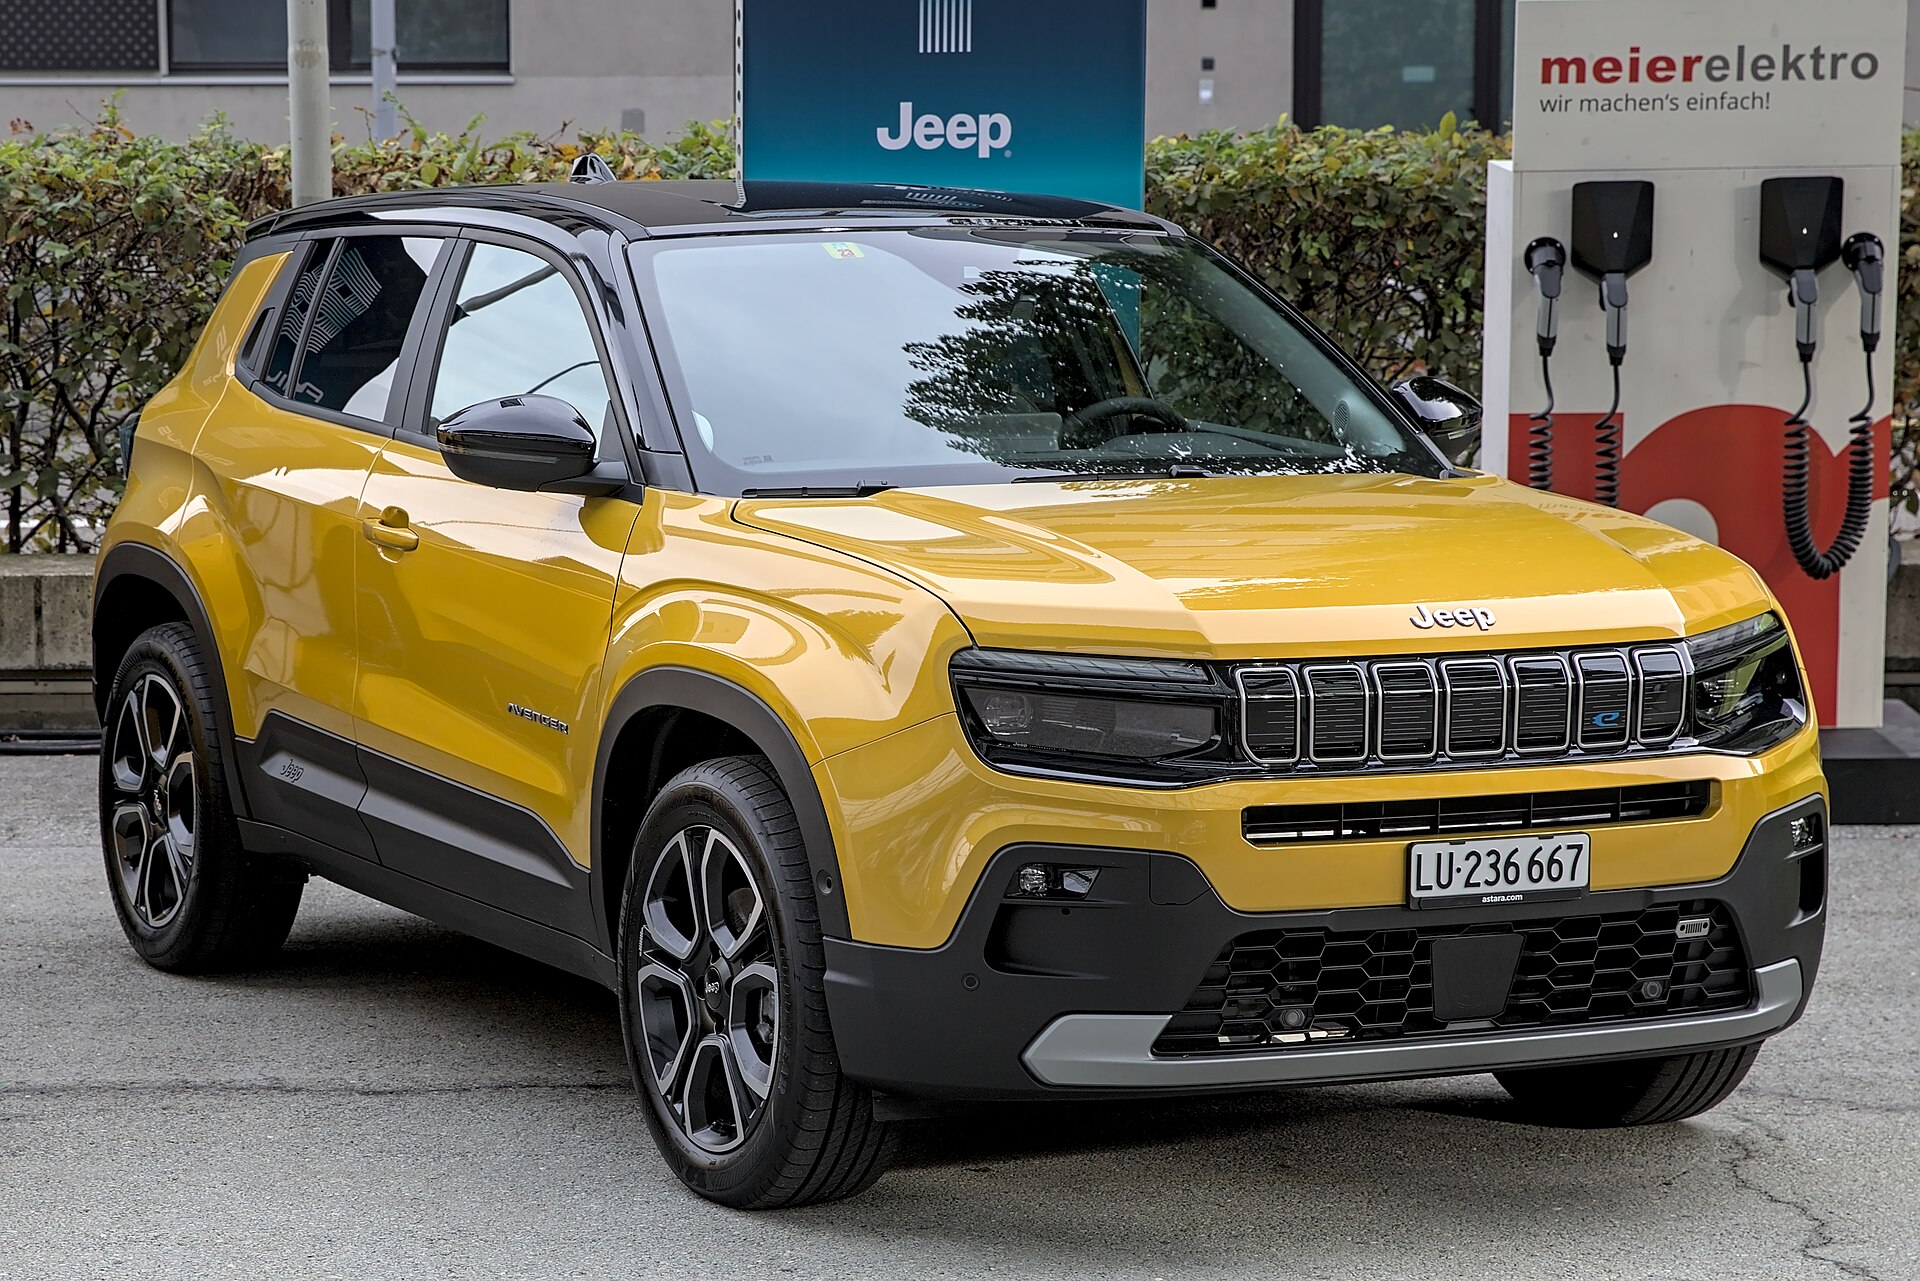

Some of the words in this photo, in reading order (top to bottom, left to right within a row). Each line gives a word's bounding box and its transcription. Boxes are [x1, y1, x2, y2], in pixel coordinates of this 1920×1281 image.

[1540, 44, 1880, 85] meierelektro
[1539, 95, 1572, 113] wir
[1580, 93, 1679, 112] machen's
[1686, 91, 1770, 111] einfach!
[876, 101, 1012, 159] Jeep
[1409, 605, 1497, 632] Jeep
[507, 702, 569, 735] AVENGER
[280, 758, 305, 784] Jeep
[1527, 843, 1585, 884] 667
[1481, 893, 1524, 904] astara.com
